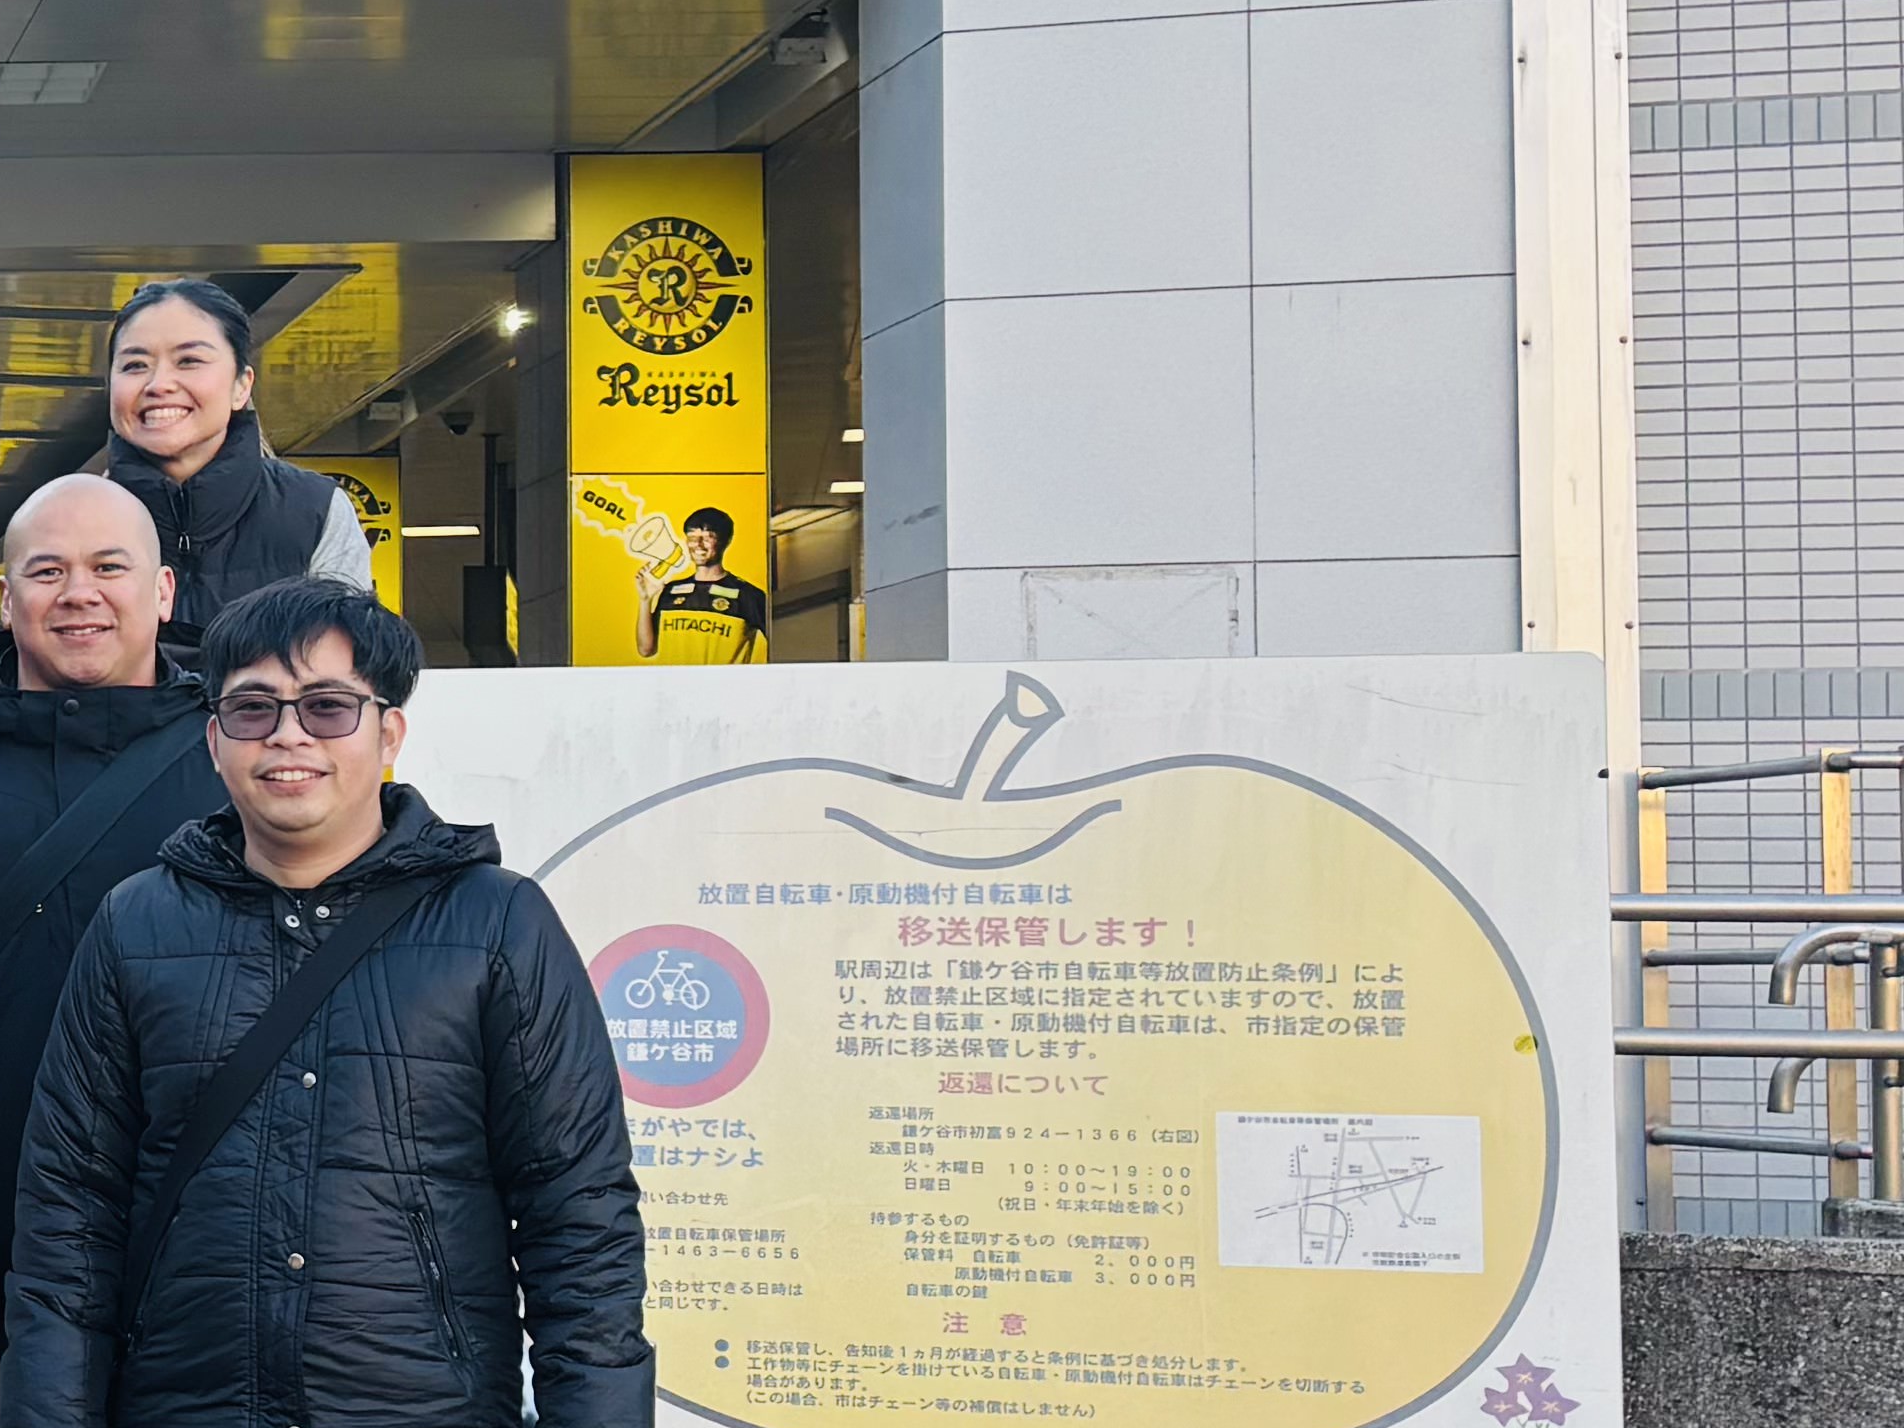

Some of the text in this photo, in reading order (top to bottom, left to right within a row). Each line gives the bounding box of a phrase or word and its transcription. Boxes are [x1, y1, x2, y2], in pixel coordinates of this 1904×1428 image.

[608, 220, 723, 261] KASHIWA
[613, 318, 723, 351] REYSOL
[597, 362, 740, 414] Reysol
[583, 490, 626, 521] GOAL
[663, 618, 731, 637] HITACHI
